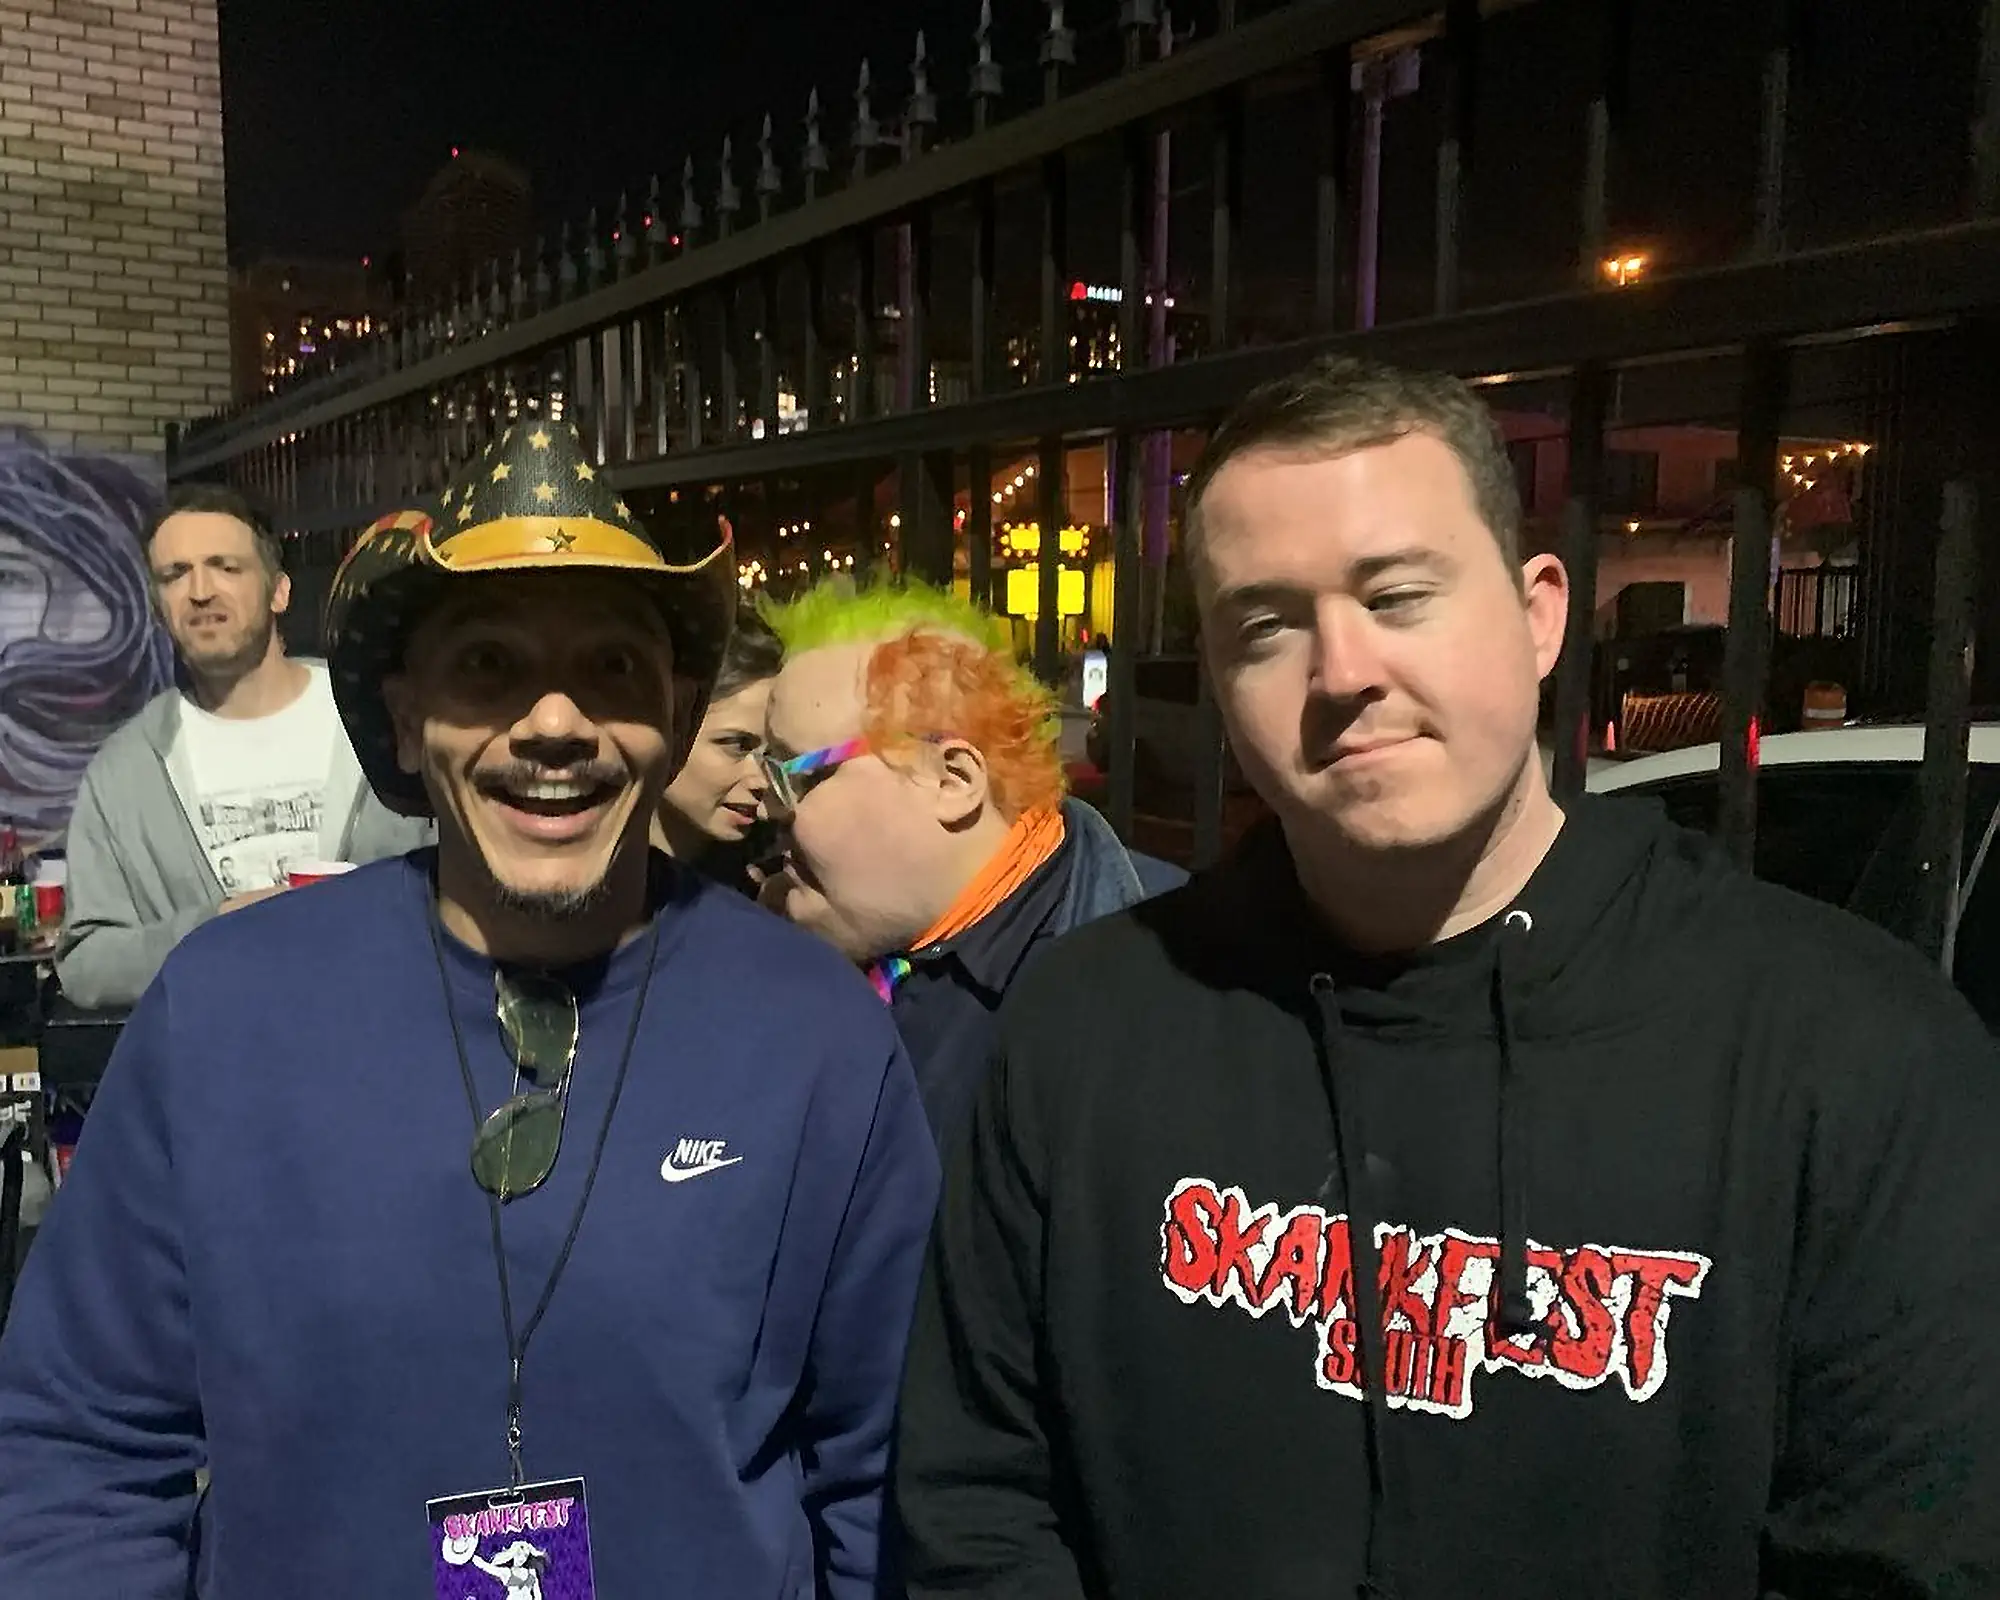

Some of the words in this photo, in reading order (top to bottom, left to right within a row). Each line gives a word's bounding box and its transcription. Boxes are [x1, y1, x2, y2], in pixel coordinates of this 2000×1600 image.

[673, 1138, 726, 1164] NIKE
[1322, 1317, 1468, 1407] SUTH
[443, 1495, 575, 1539] SKANKFEST
